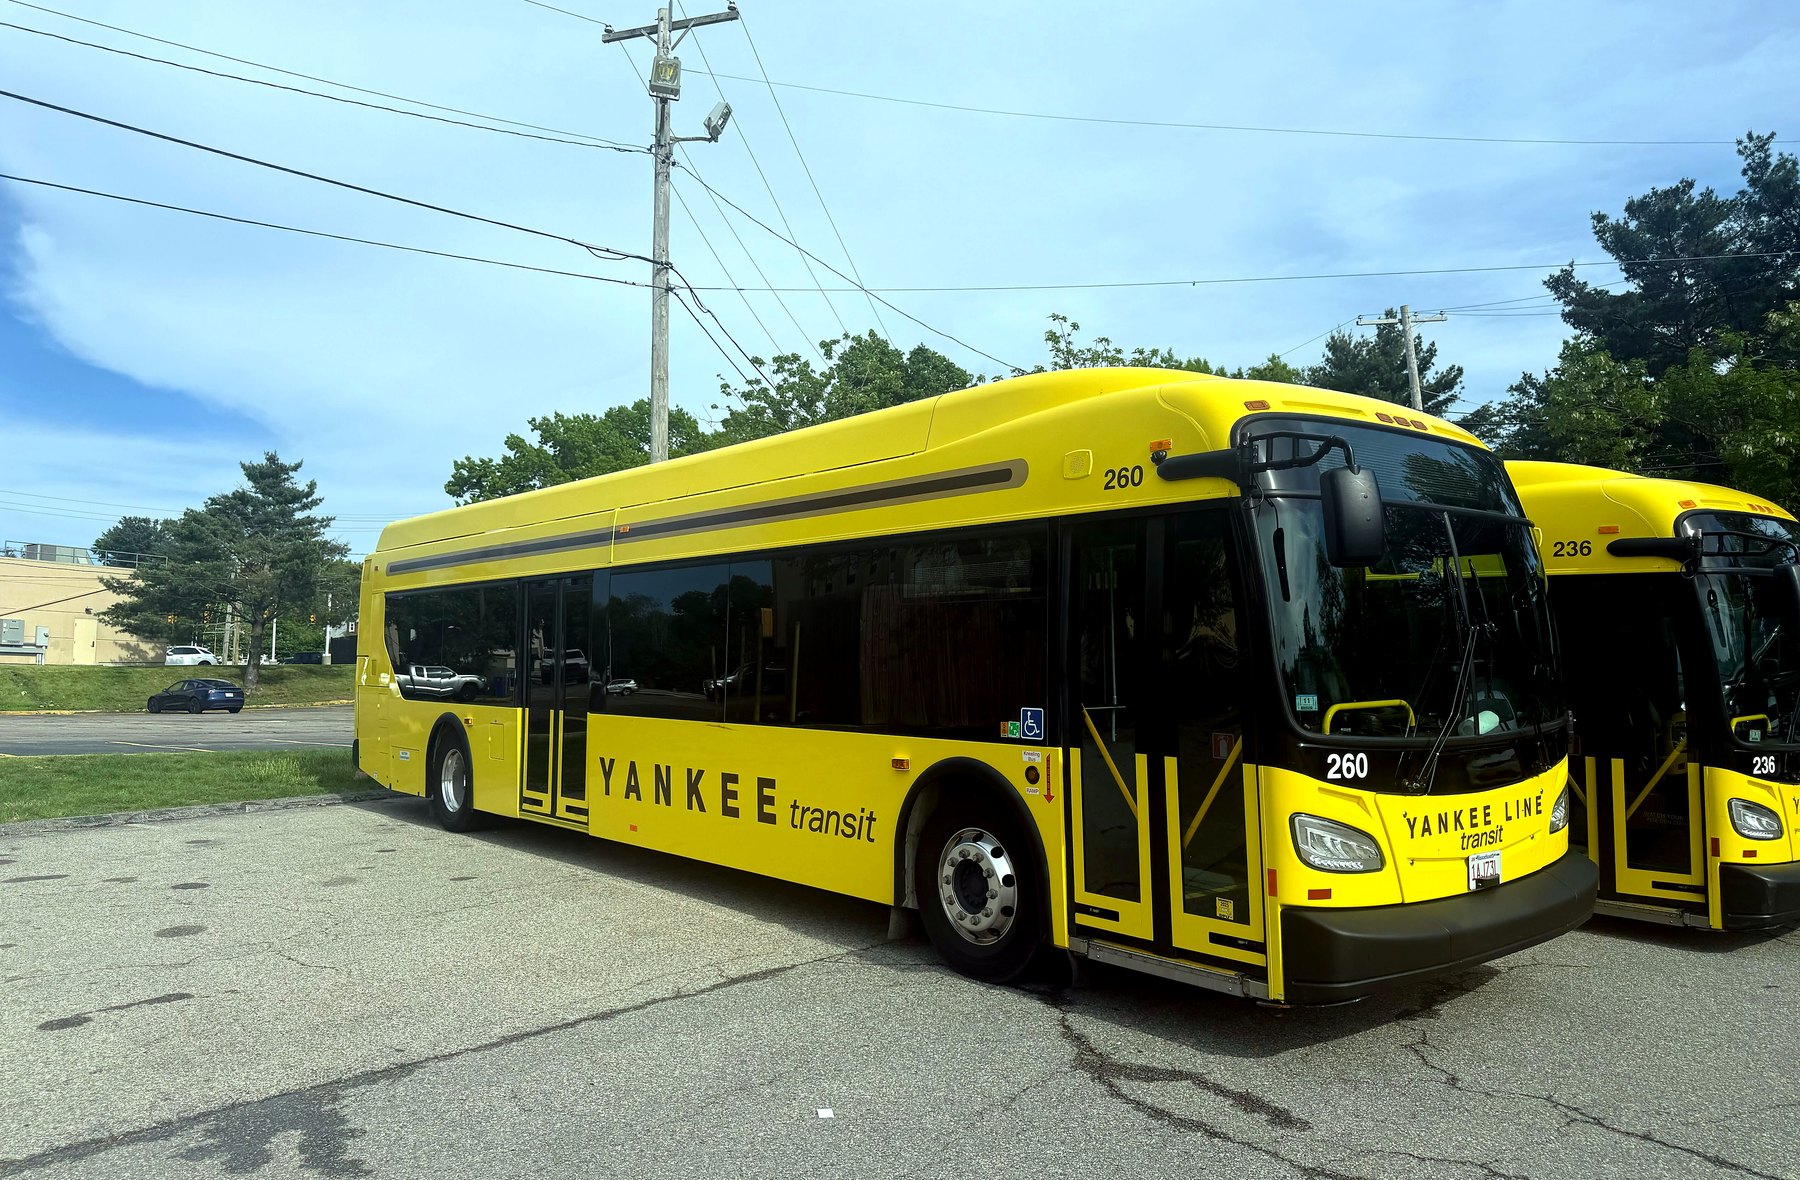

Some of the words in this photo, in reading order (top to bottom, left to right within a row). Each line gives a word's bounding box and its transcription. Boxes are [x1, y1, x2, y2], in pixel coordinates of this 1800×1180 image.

[1104, 465, 1143, 490] 260
[1553, 540, 1592, 557] 236
[1327, 752, 1368, 779] 260
[1753, 756, 1775, 775] 236
[599, 757, 777, 825] YANKEE
[790, 799, 877, 843] transit
[1406, 805, 1492, 839] YANKEE
[1505, 795, 1543, 822] LINE
[1460, 825, 1503, 851] transit
